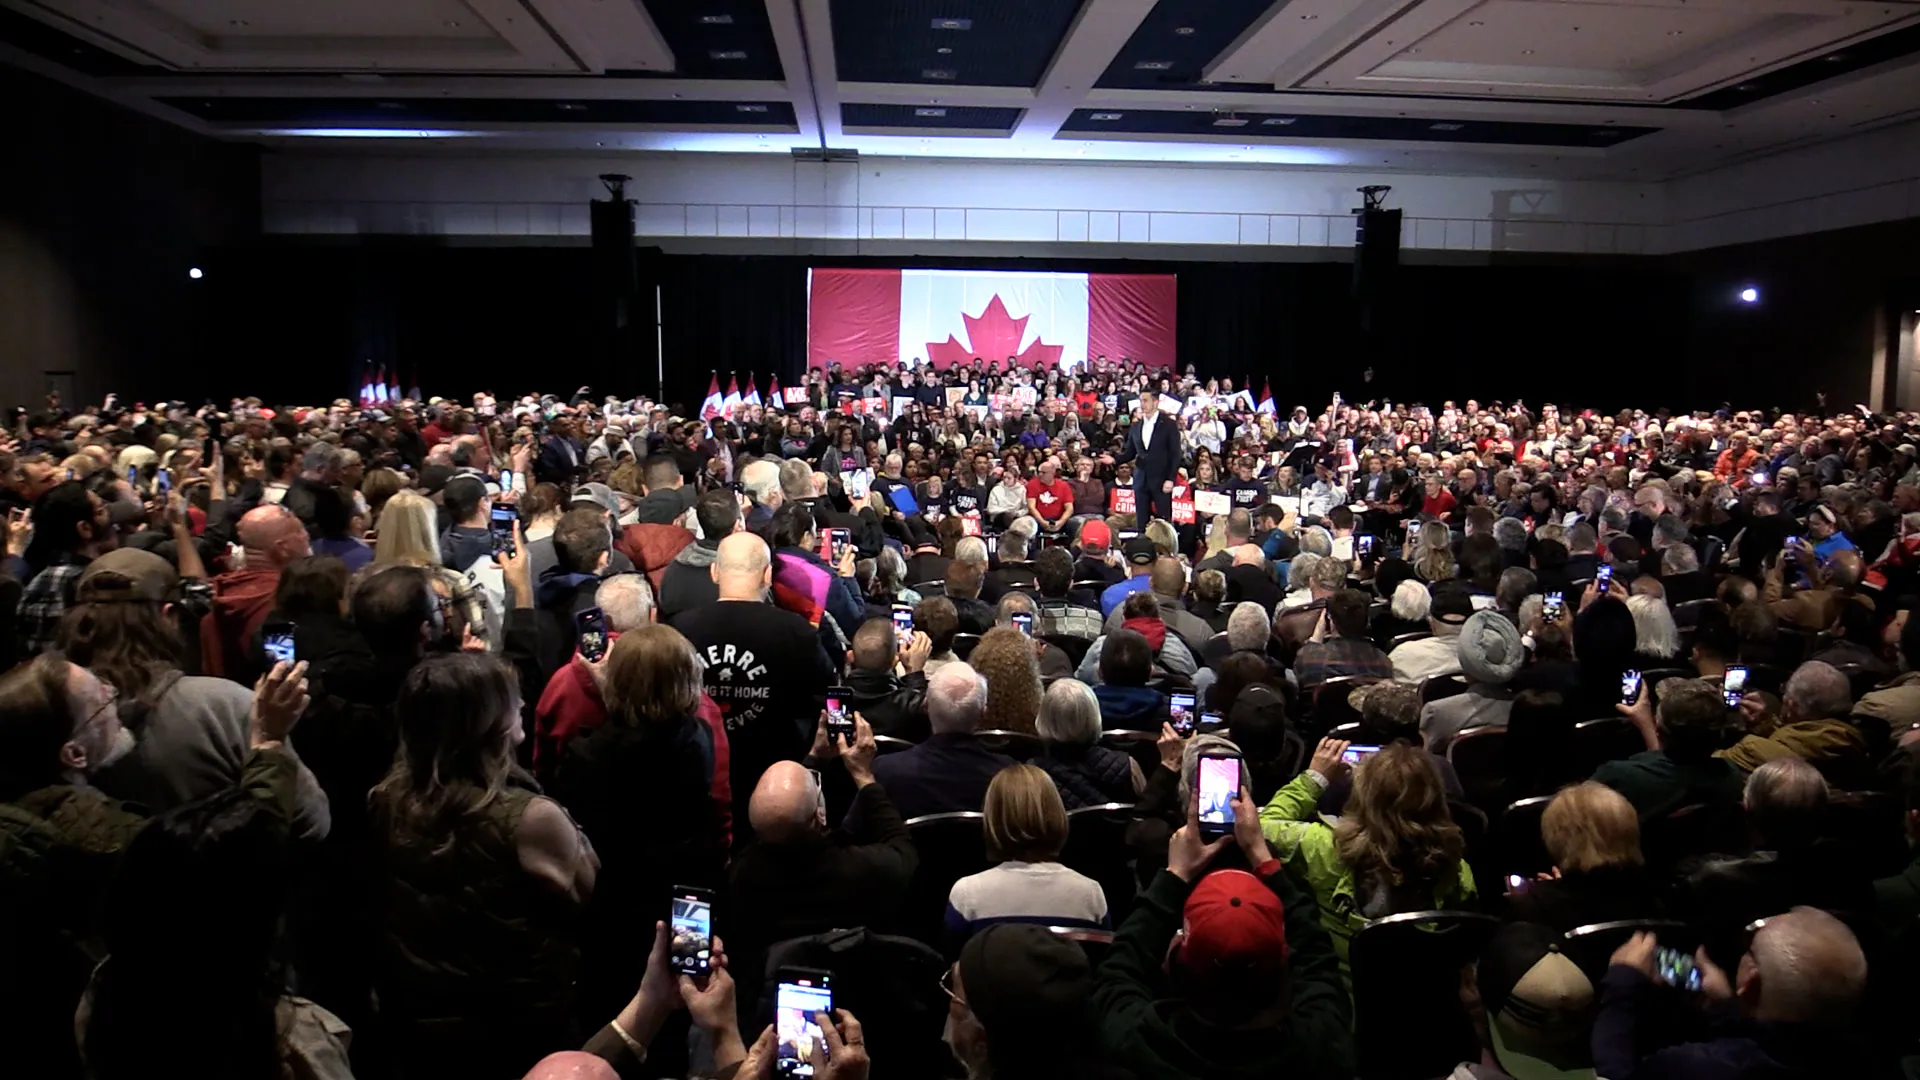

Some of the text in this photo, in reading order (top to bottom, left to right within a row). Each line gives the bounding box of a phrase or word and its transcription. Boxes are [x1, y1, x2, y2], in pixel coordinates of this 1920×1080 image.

[1115, 503, 1137, 513] CRIM
[697, 644, 767, 681] IERRE
[719, 686, 732, 697] IT
[734, 687, 771, 699] HOME
[726, 702, 765, 731] EVRE
